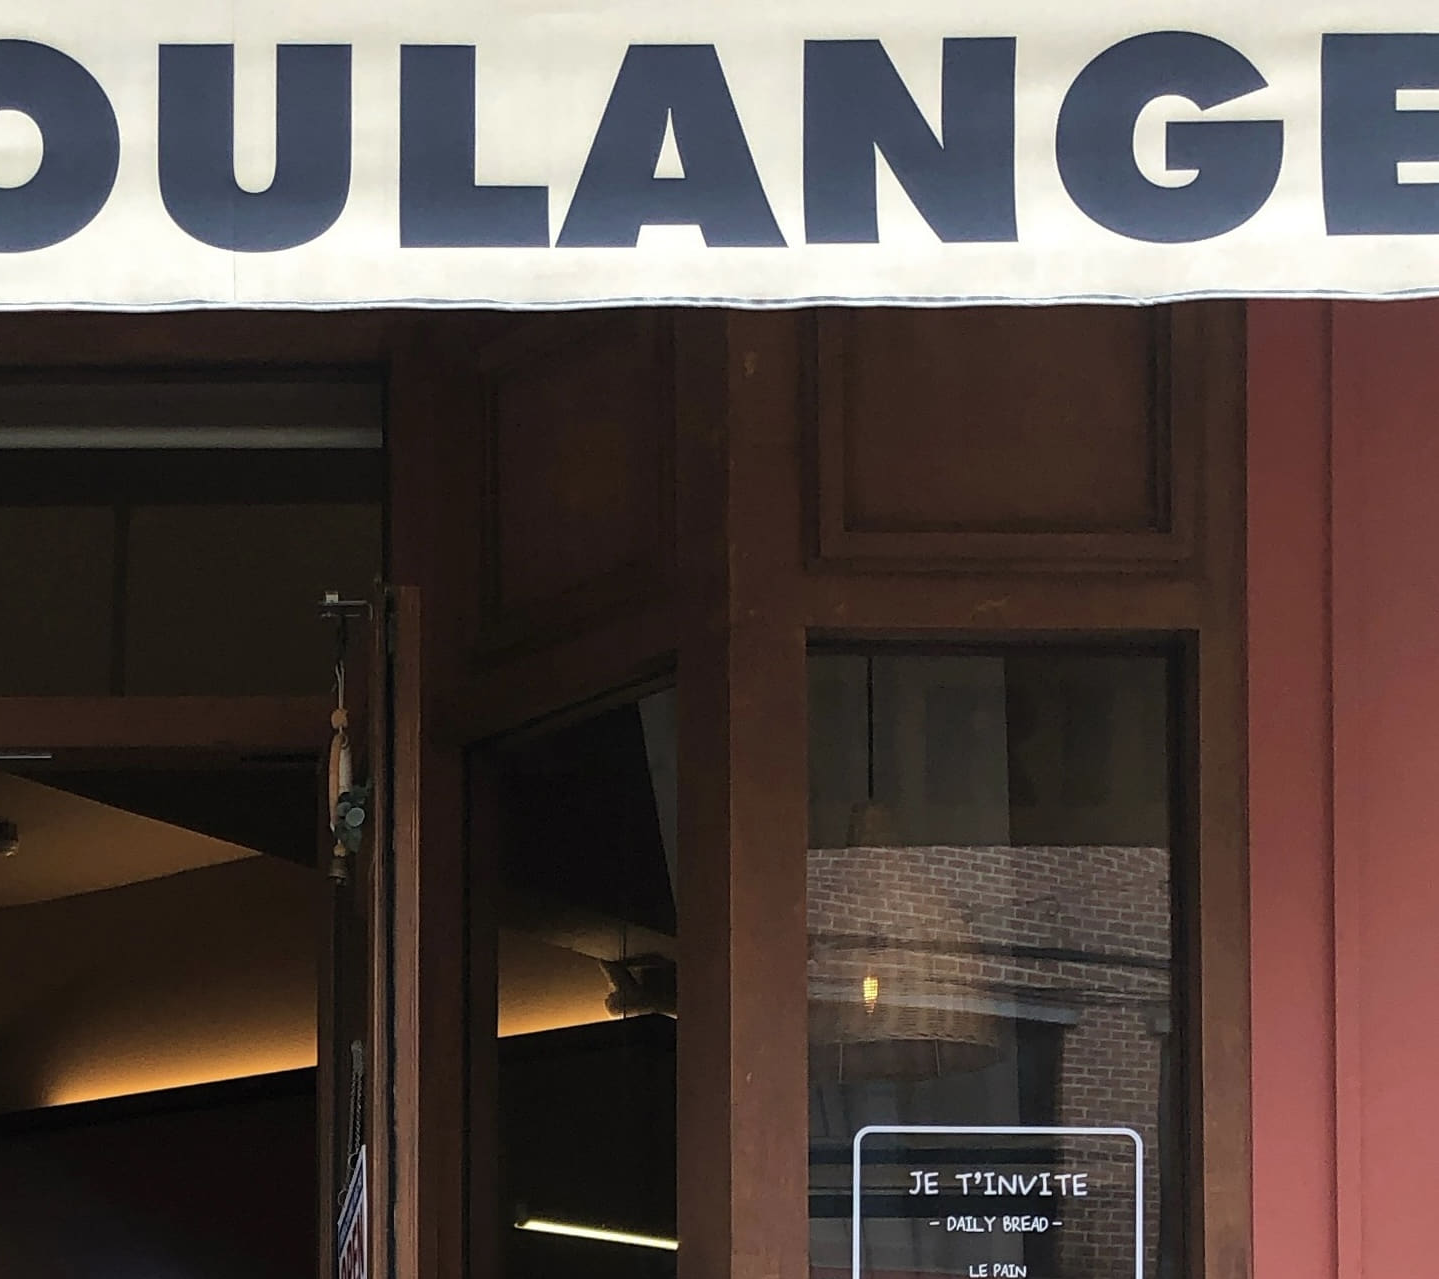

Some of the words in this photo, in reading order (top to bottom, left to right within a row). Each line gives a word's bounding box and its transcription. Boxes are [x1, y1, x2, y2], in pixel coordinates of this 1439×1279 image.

[908, 1170, 940, 1196] JE
[954, 1170, 1089, 1197] T'INVITE
[946, 1215, 997, 1233] DAILY
[1002, 1215, 1050, 1233] BREAD
[968, 1263, 988, 1278] LE
[993, 1264, 1028, 1278] PAIN
